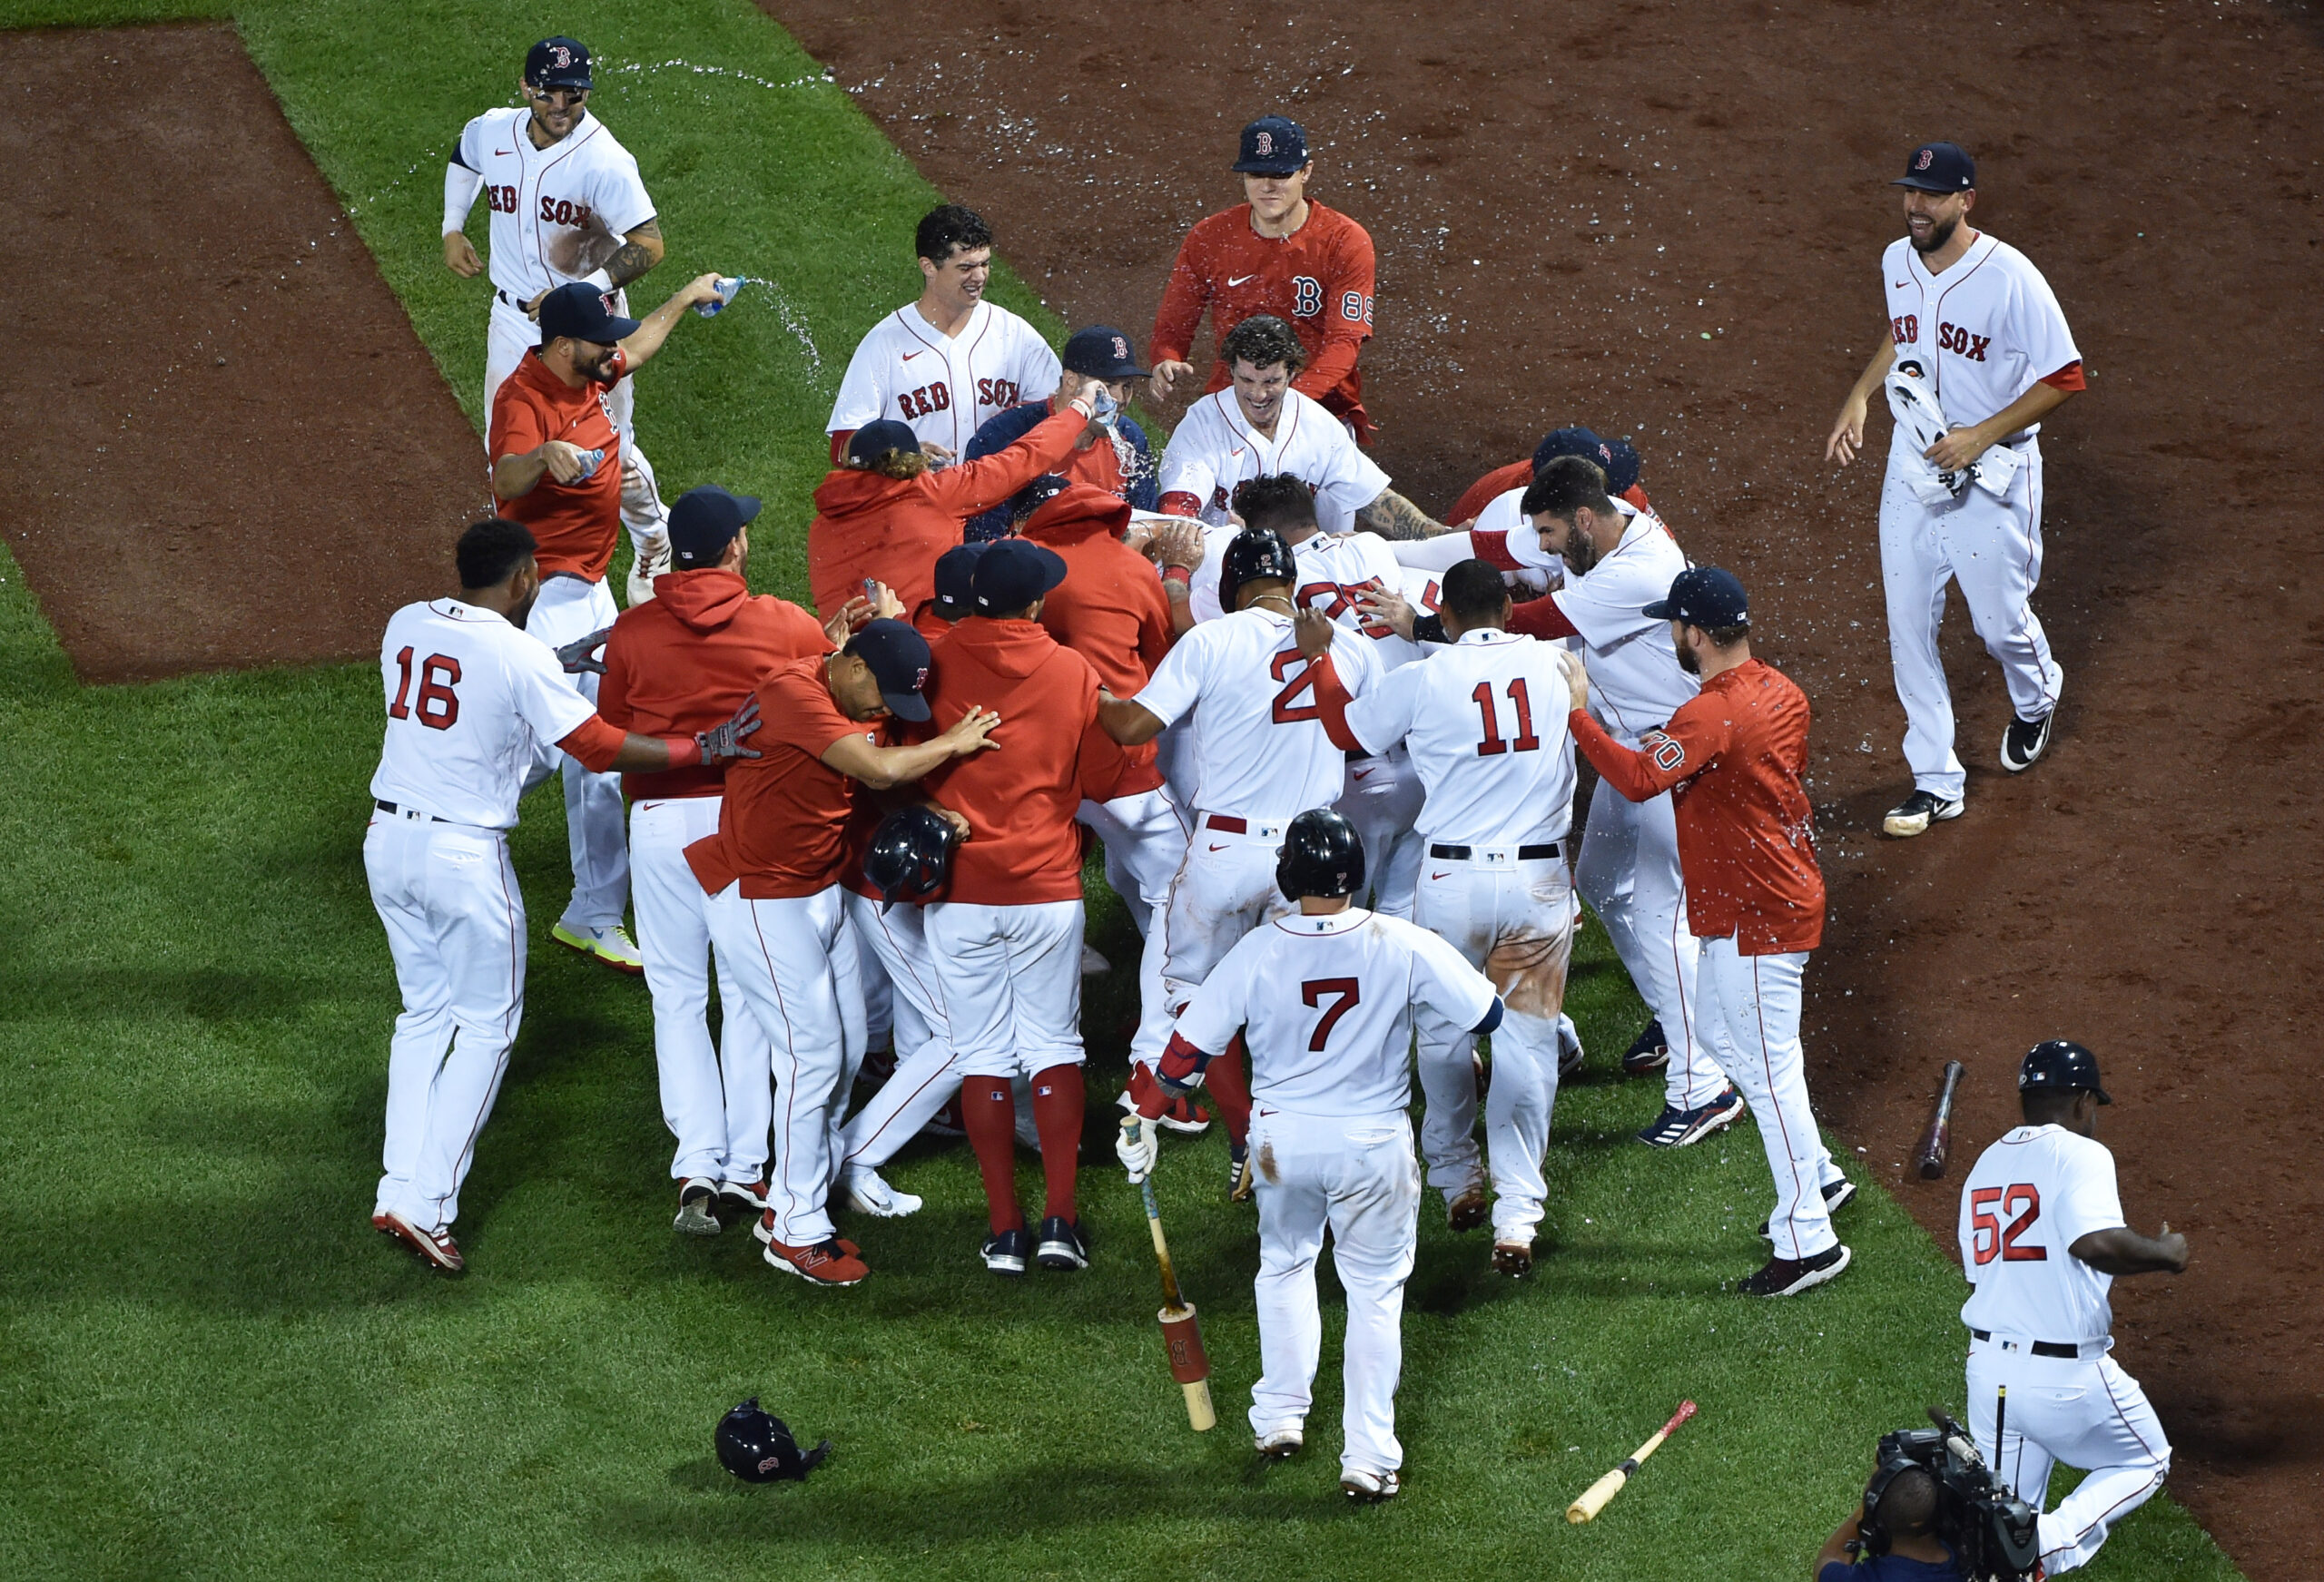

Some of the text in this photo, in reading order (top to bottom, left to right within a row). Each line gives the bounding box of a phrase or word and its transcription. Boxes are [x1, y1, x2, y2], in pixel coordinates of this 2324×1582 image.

[554, 46, 571, 69] B
[1256, 132, 1272, 155] B
[1915, 150, 1934, 170] B
[540, 195, 592, 230] SOX
[1292, 276, 1323, 316] B
[1111, 337, 1128, 359] B
[1939, 321, 1991, 361] SOX
[897, 378, 1020, 421] RED SOX
[1261, 554, 1272, 566] 2
[389, 645, 463, 732] 16
[1472, 677, 1540, 757] 11
[1336, 871, 1347, 886] 7
[1301, 977, 1361, 1053] 7
[1971, 1183, 2048, 1266] 52
